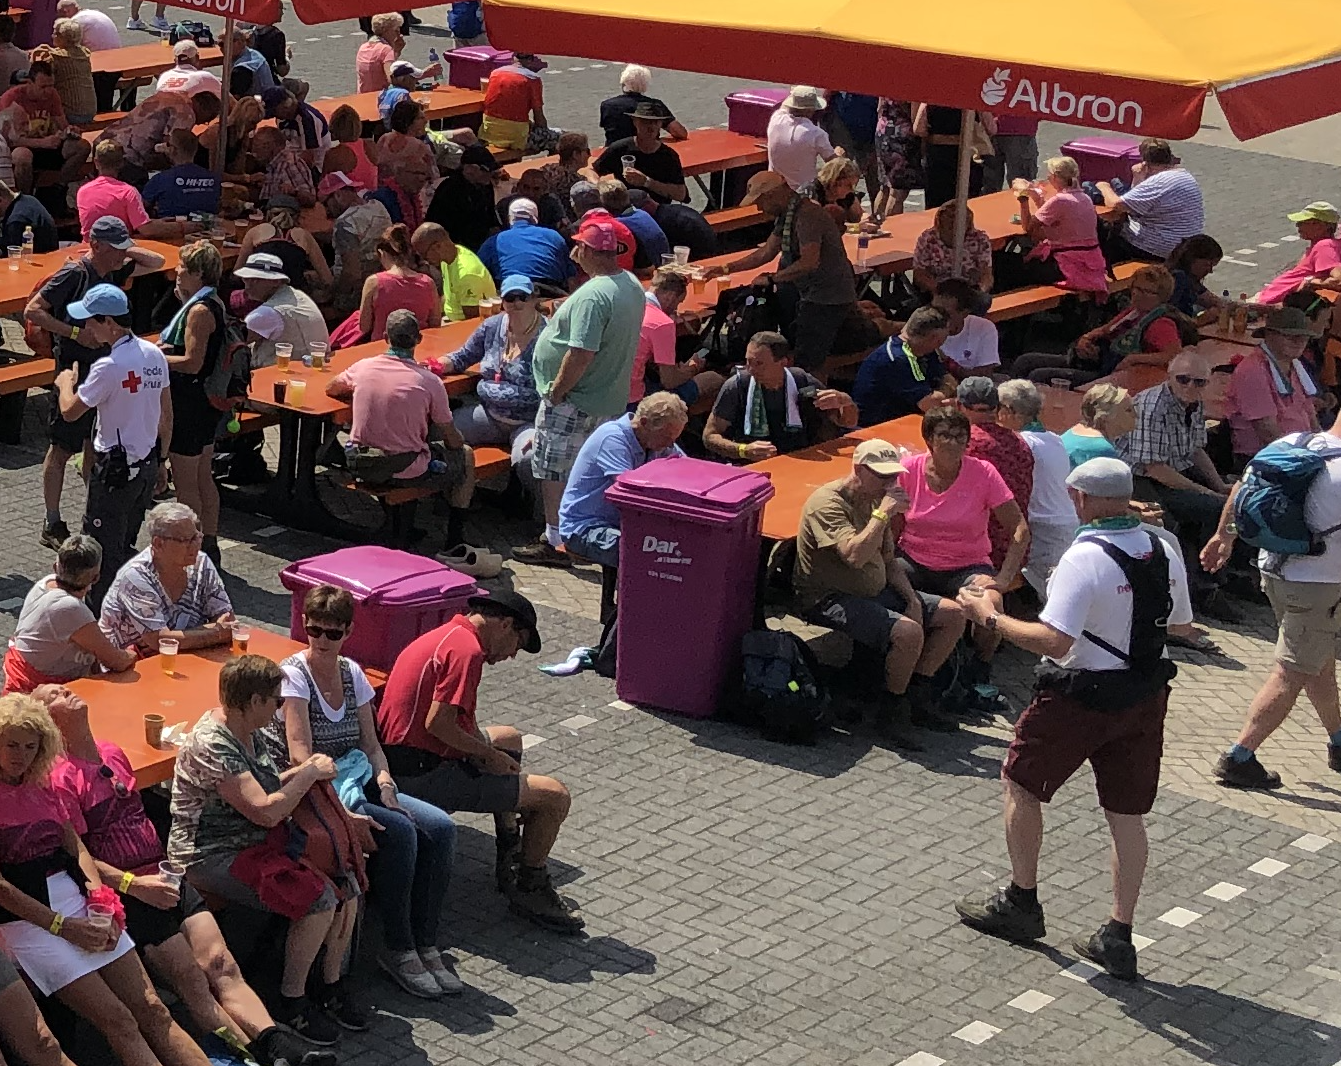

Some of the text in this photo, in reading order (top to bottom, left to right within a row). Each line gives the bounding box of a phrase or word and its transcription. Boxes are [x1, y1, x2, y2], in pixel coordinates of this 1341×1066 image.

[1008, 79, 1143, 128] Albron
[185, 178, 215, 187] HI-TEC
[642, 535, 683, 557] Dar.
